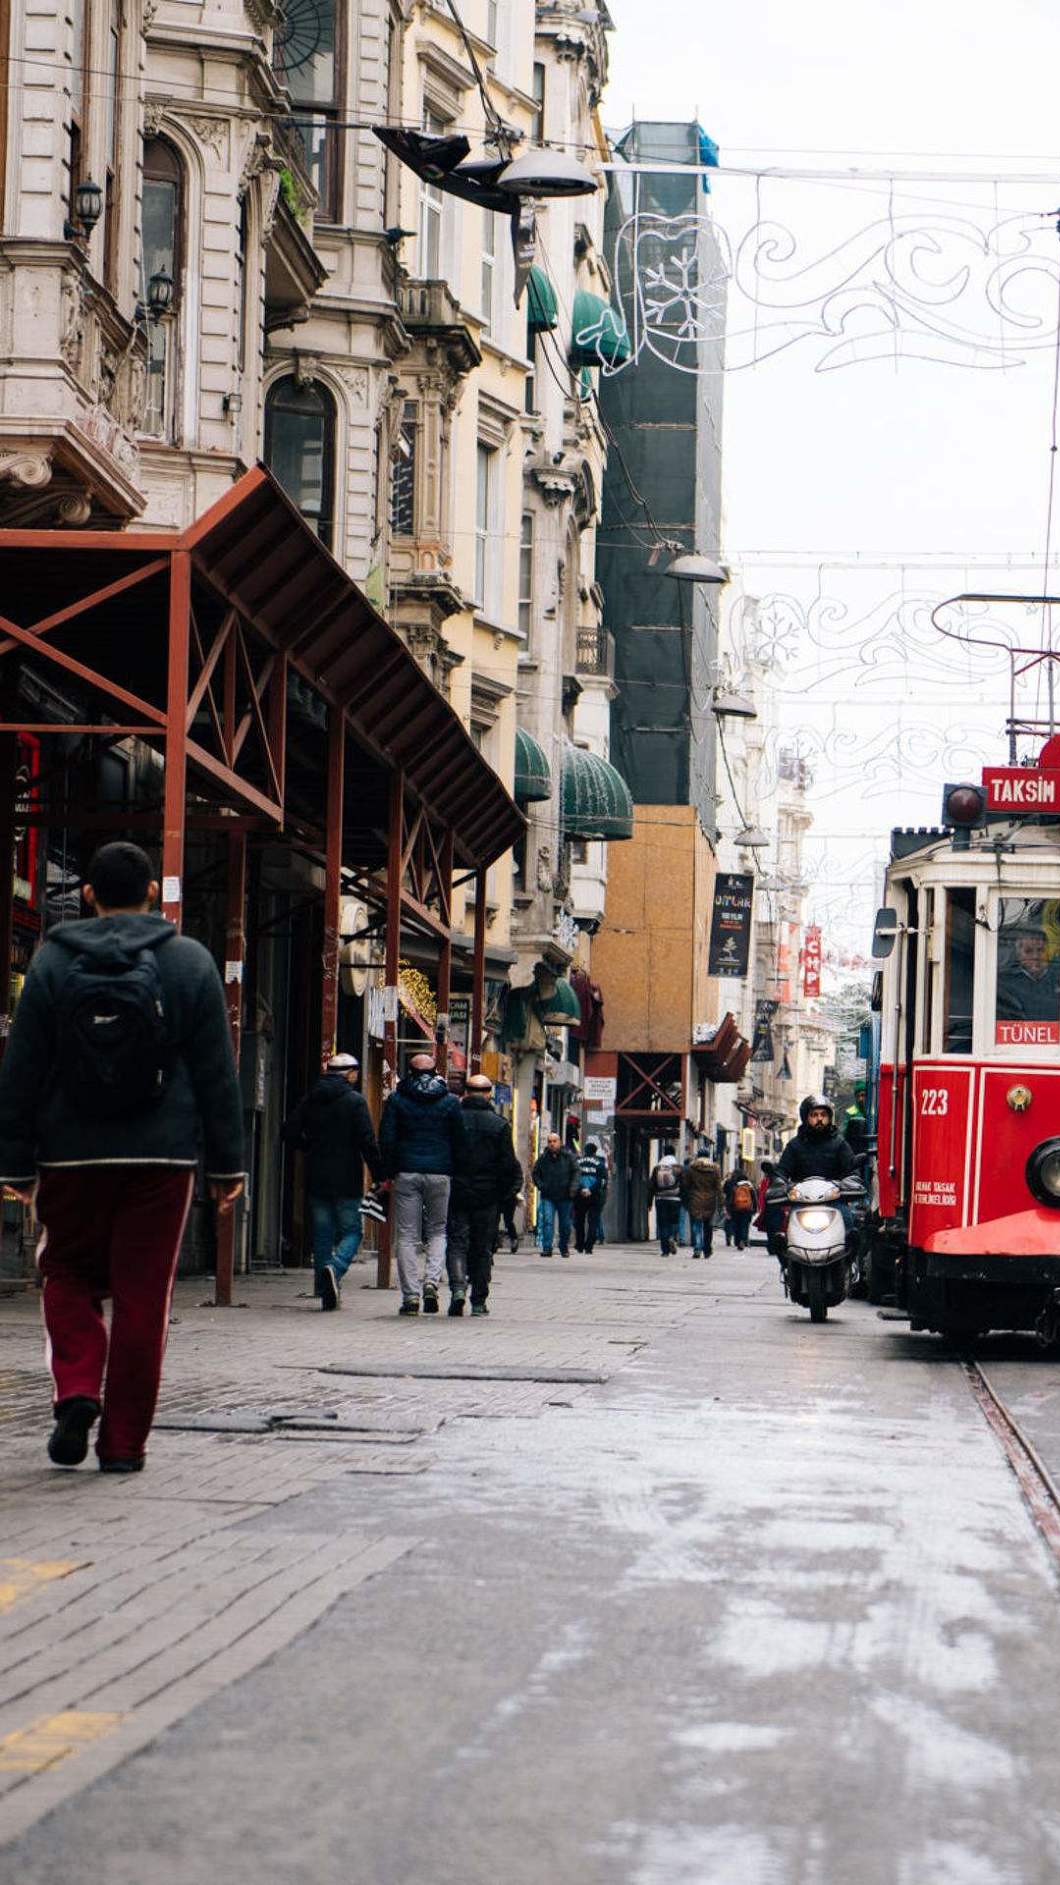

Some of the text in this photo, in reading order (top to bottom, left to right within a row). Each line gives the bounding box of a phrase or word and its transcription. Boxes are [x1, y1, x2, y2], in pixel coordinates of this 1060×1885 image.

[991, 775, 1055, 803] TAKSİM
[805, 940, 820, 985] CHP
[1000, 1023, 1056, 1043] TÜNEL
[921, 1088, 949, 1116] 223
